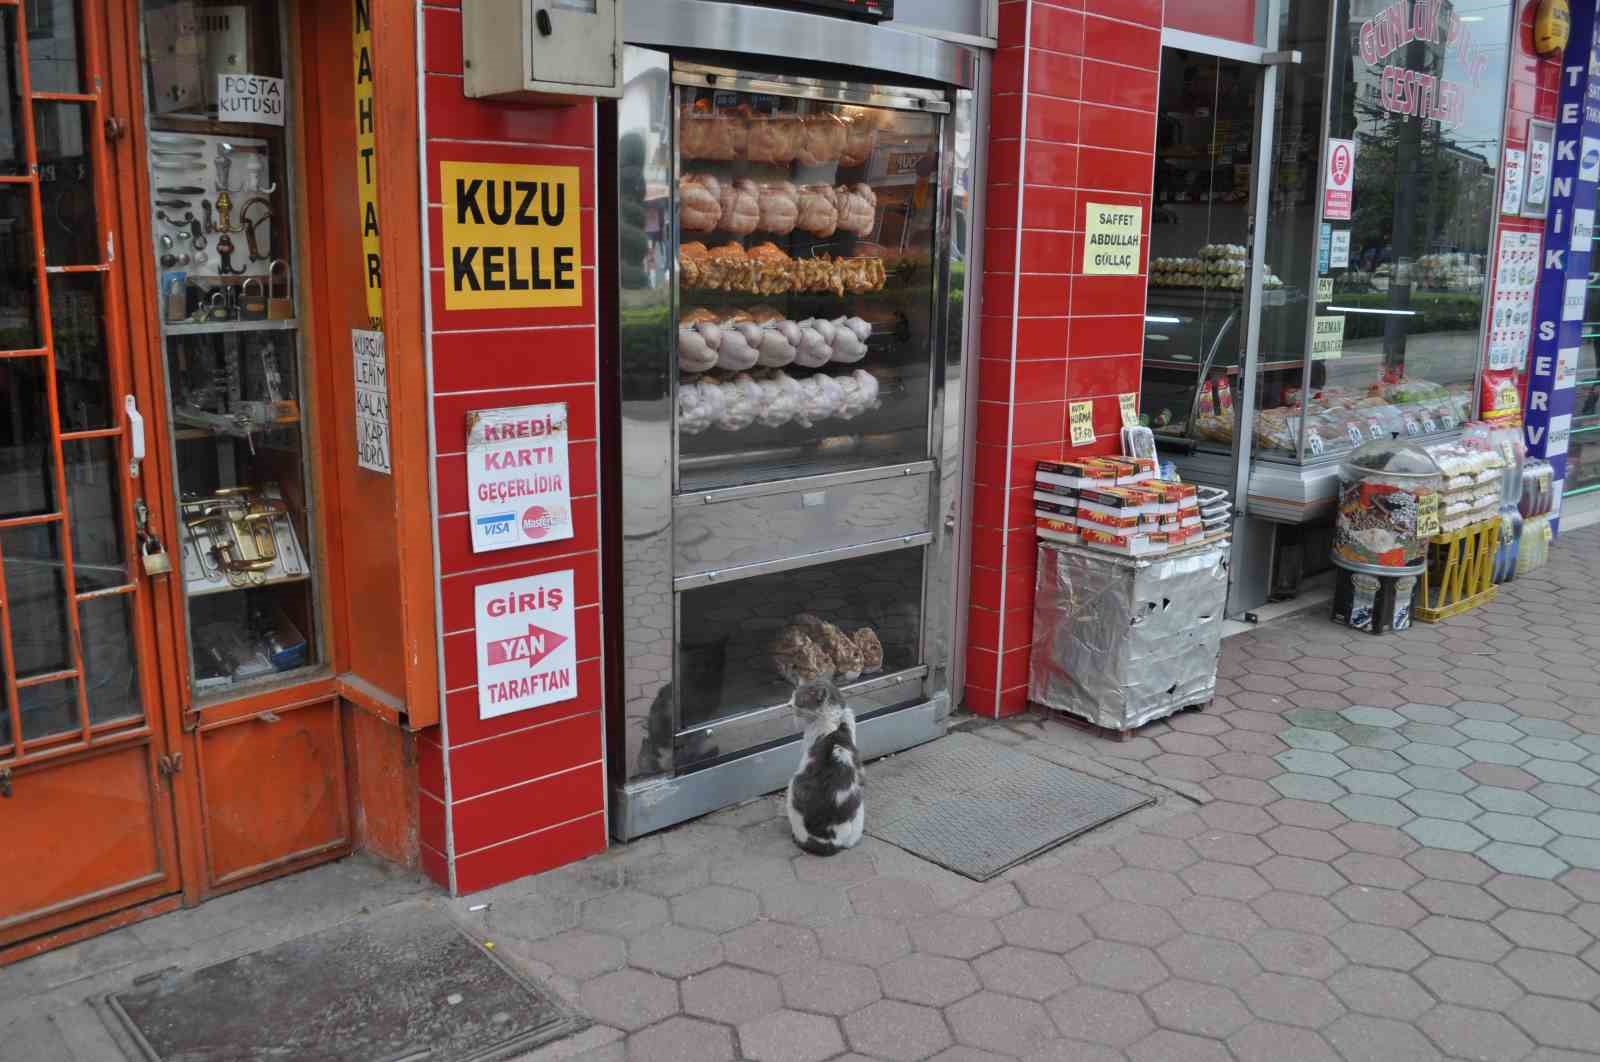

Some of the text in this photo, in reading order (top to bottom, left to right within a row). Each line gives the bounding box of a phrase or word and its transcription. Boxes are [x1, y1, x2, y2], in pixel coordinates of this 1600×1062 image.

[225, 76, 280, 96] POSTA
[219, 97, 281, 114] KUTUSU
[1545, 65, 1584, 270] TEKNİK
[456, 178, 565, 227] KUZU
[1098, 213, 1135, 226] SAFFET
[1089, 233, 1140, 247] ABDULLAH
[451, 246, 575, 291] KELLE
[1094, 252, 1131, 269] GÜLLAÇ
[484, 414, 553, 441] KREDİ
[484, 446, 554, 471] KARTI
[484, 522, 510, 537] VISA
[486, 587, 564, 618] GİRİŞ
[501, 634, 545, 661] YAN
[488, 668, 570, 704] TARAFTAN
